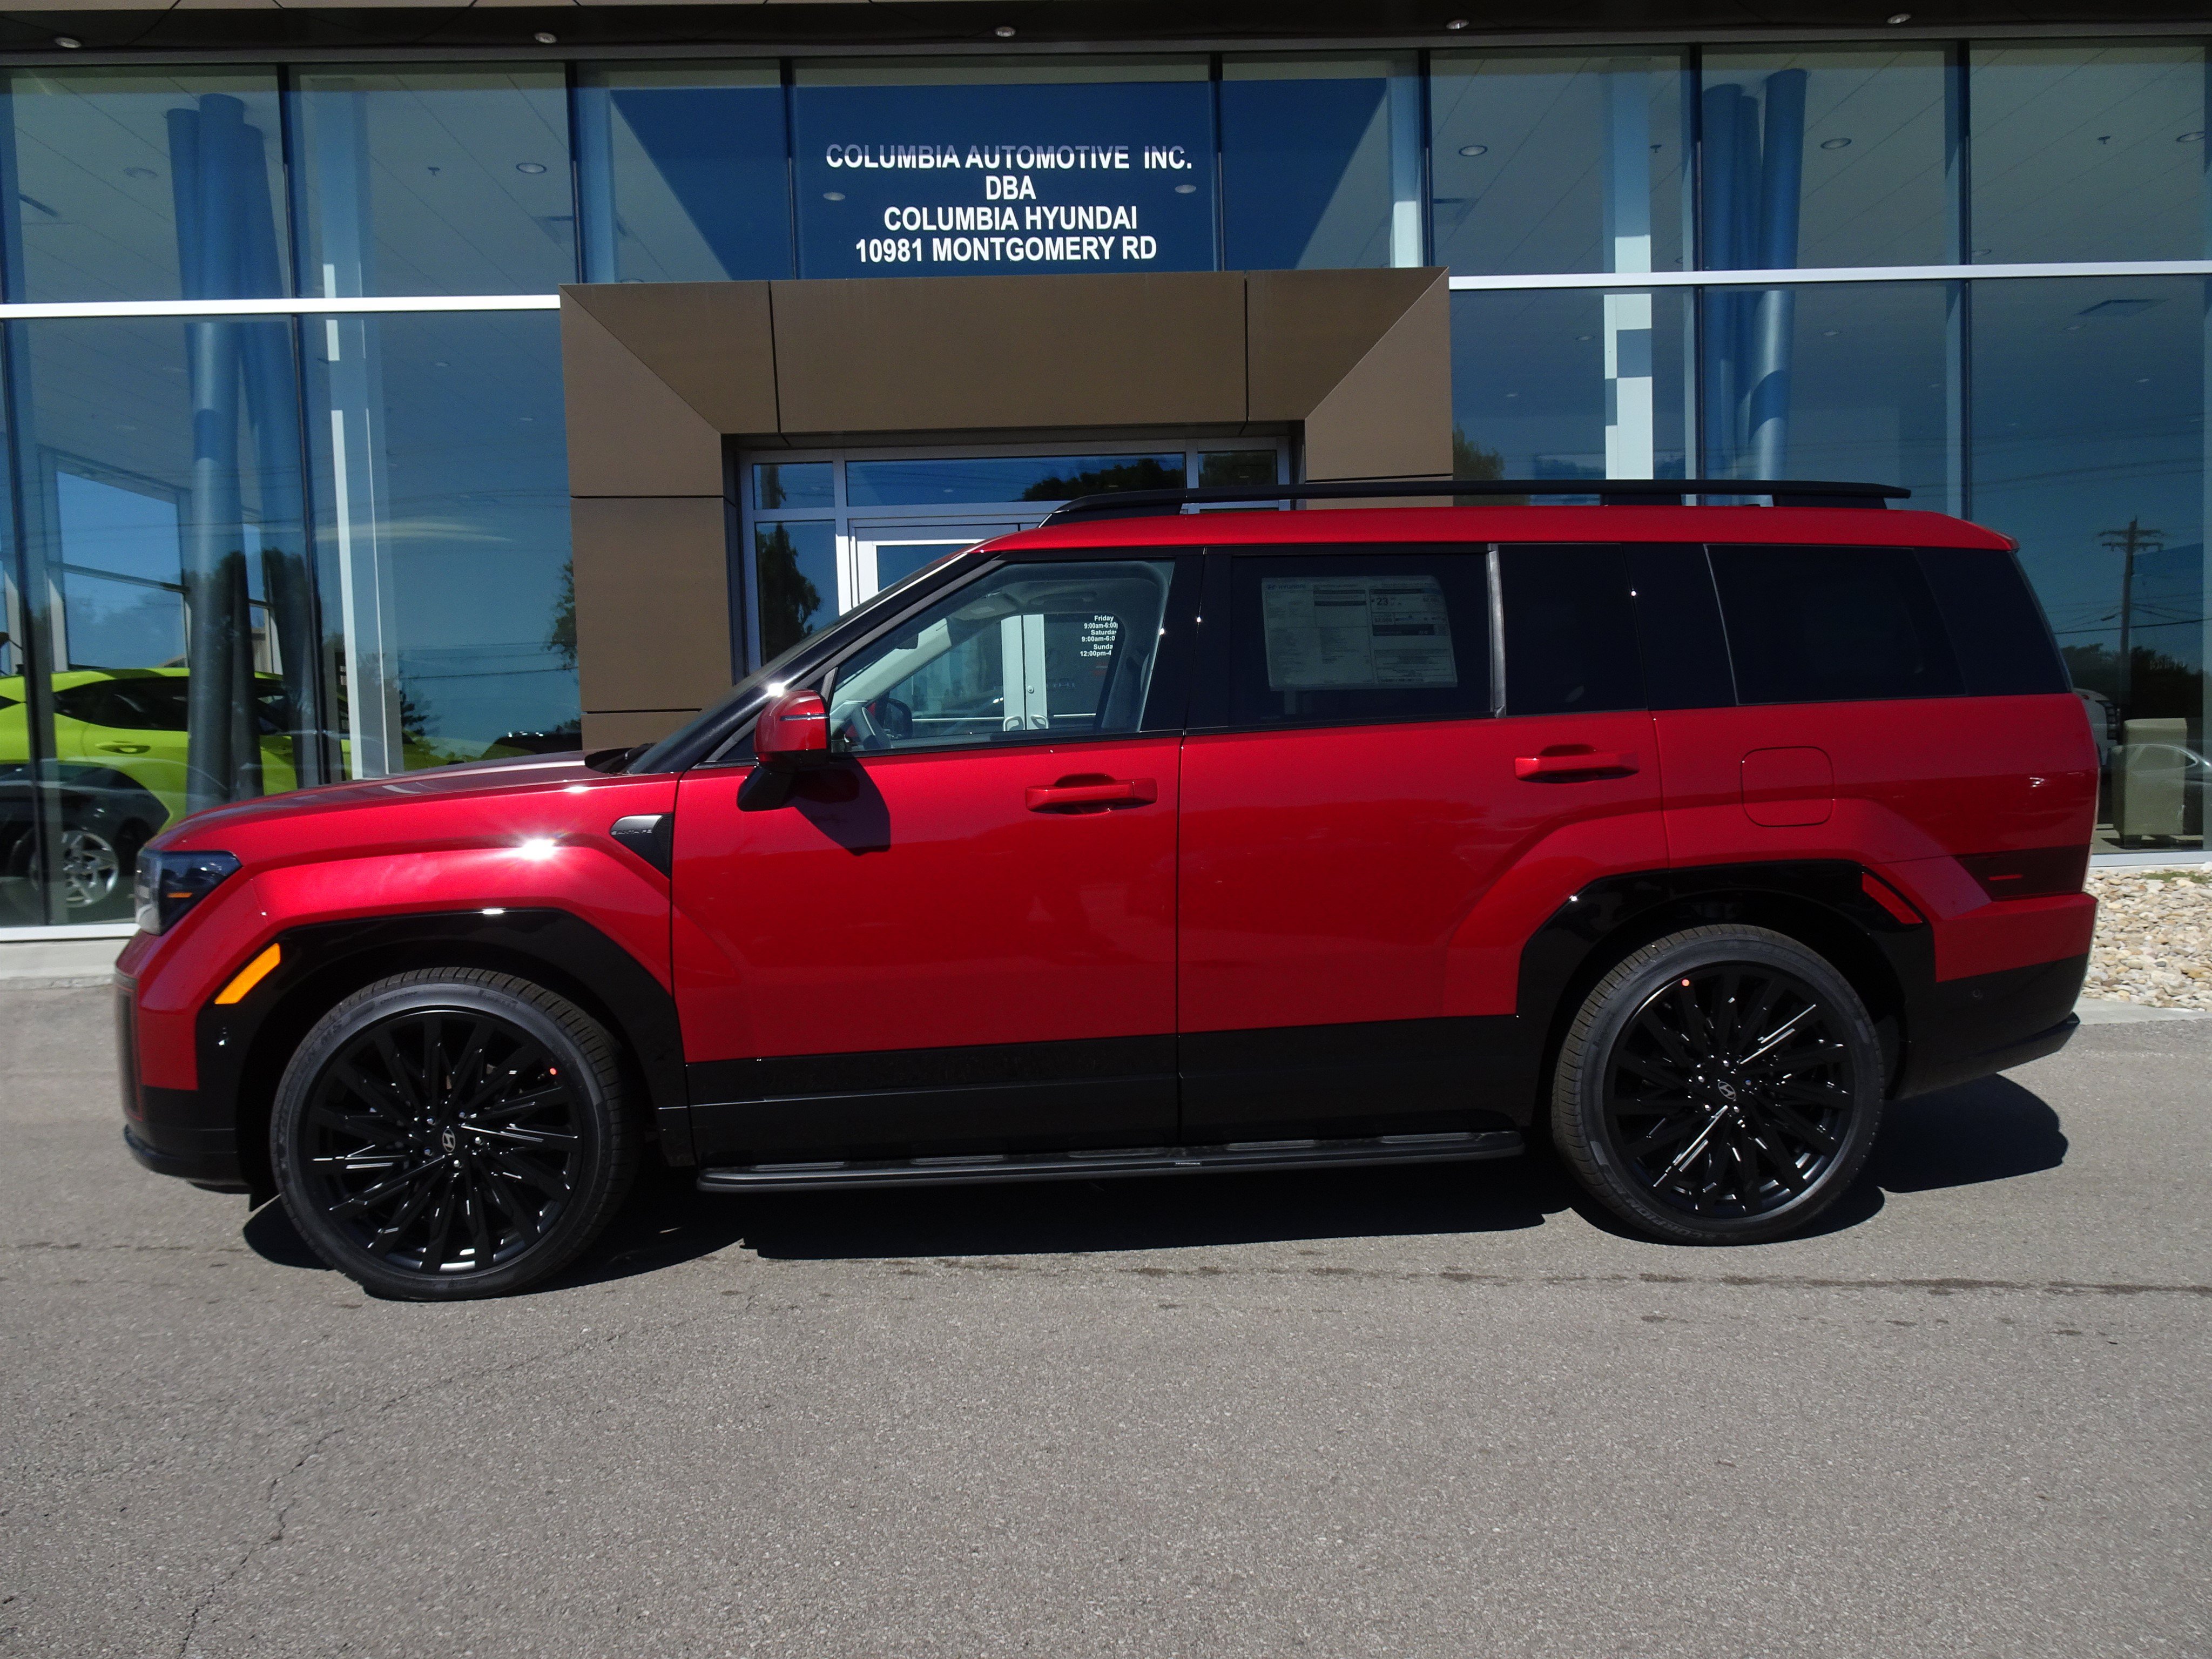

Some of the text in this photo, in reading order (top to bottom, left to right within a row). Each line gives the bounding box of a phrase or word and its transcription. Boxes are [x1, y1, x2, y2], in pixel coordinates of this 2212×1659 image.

[826, 144, 1192, 170] COLUMBIA AUTOMOTIVE INC.
[986, 175, 1036, 200] DBA
[884, 205, 1137, 231] COLUMBIA HYUNDAI
[856, 235, 1157, 263] 10981 MONTGOMERY RD
